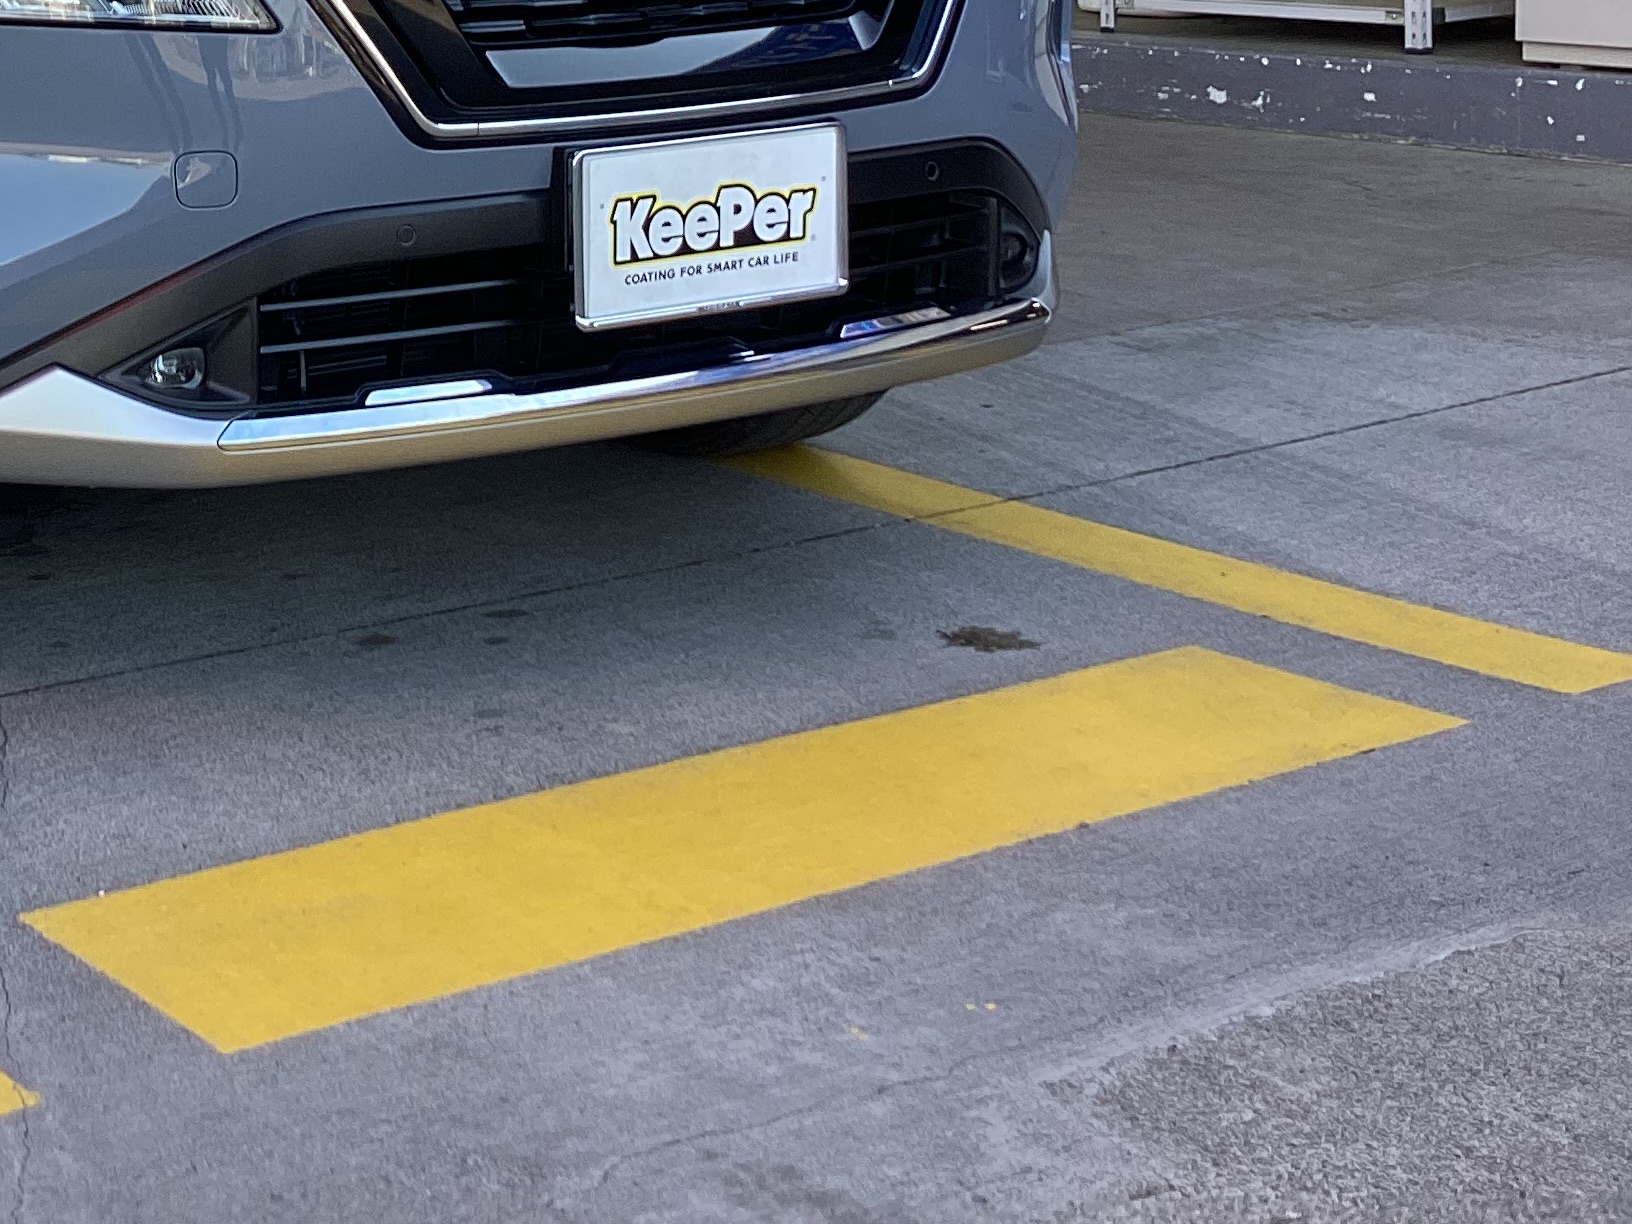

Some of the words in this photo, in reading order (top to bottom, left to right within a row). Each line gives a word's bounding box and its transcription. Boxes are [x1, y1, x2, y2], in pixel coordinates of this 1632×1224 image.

[611, 183, 818, 266] KeePer
[624, 268, 676, 286] COATING
[679, 263, 703, 278] FOR
[707, 258, 744, 275] SMART
[747, 255, 771, 268] CAR
[773, 251, 799, 265] LIFE
